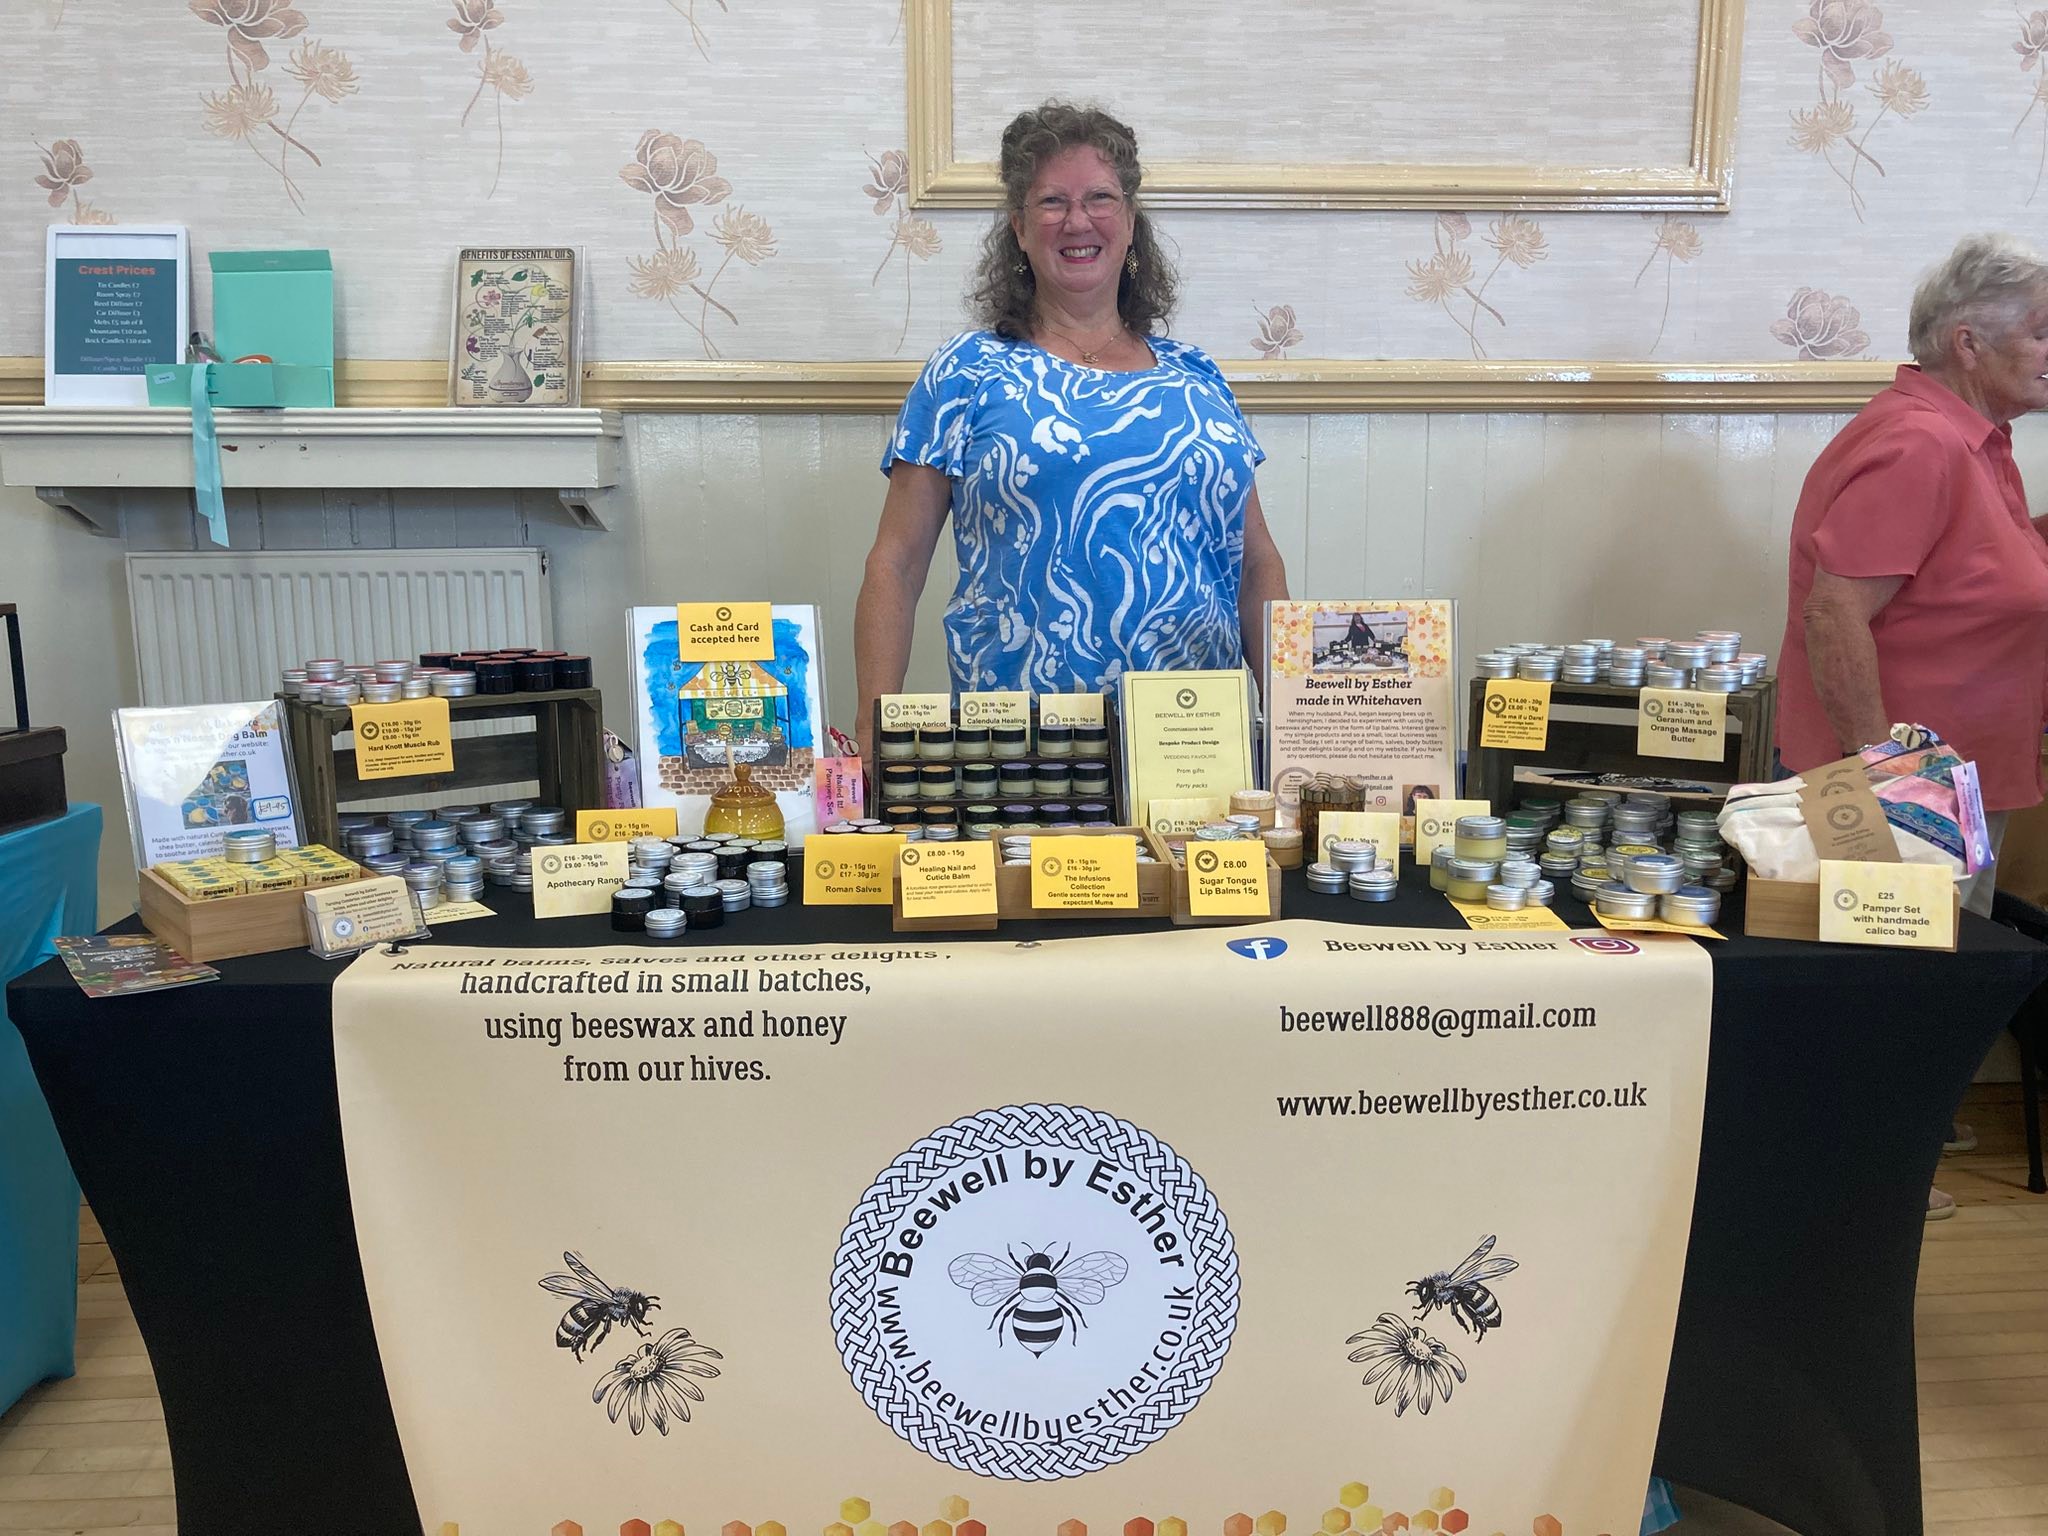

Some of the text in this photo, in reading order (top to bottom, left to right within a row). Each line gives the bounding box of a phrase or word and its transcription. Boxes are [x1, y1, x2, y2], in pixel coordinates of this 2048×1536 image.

[461, 250, 498, 260] BENEFITS
[500, 250, 510, 260] OF
[512, 249, 552, 259] ESSENTIAL
[79, 265, 156, 276] Crest Prices
[690, 622, 759, 632] Cash and Card
[690, 634, 760, 644] accepted here
[1305, 678, 1412, 692] Beewell by Esther
[1296, 694, 1422, 706] made in Whitehaven
[1001, 718, 1026, 726] Healing
[1656, 714, 1694, 725] Geranium
[242, 730, 268, 738] Balm
[1650, 724, 1718, 736] Orange Massage
[241, 740, 269, 748] website:
[1671, 734, 1696, 743] Butter
[368, 744, 384, 752] Hard
[628, 823, 640, 831] 15g
[632, 830, 644, 838] 30g
[152, 836, 170, 844] Made
[581, 854, 592, 862] 30g
[952, 850, 965, 858] 15g
[919, 866, 946, 874] Healing
[1224, 860, 1247, 869] £8.00
[322, 872, 350, 882] Beewell
[1200, 876, 1257, 887] Sugar Tongue
[262, 880, 292, 890] Beewell
[546, 877, 624, 890] Apothecary Range
[202, 886, 234, 897] Beewell
[1200, 887, 1258, 897] Lip Balms 15g
[1878, 892, 1894, 900] £25
[1862, 904, 1921, 914] Pamper Set
[1853, 914, 1930, 926] with handmade
[1865, 926, 1917, 938] calico bag
[1324, 939, 1559, 955] Beewell by Esther
[391, 958, 496, 971] Natural
[600, 954, 689, 966] salves
[696, 952, 748, 964] and
[754, 950, 827, 963] other
[831, 948, 938, 964] delights
[460, 968, 872, 996] handcrafted in small batches,
[1280, 1003, 1597, 1038] beewell888@gmail.com
[484, 1012, 848, 1046] using beeswax and honey
[562, 1054, 772, 1082] from our hives.
[1277, 1082, 1648, 1120] www.beewellbyesther.co.uk
[880, 1149, 1185, 1279] Beewell by Esther
[876, 1285, 1195, 1447] www.beewellbyesther.co.uk
